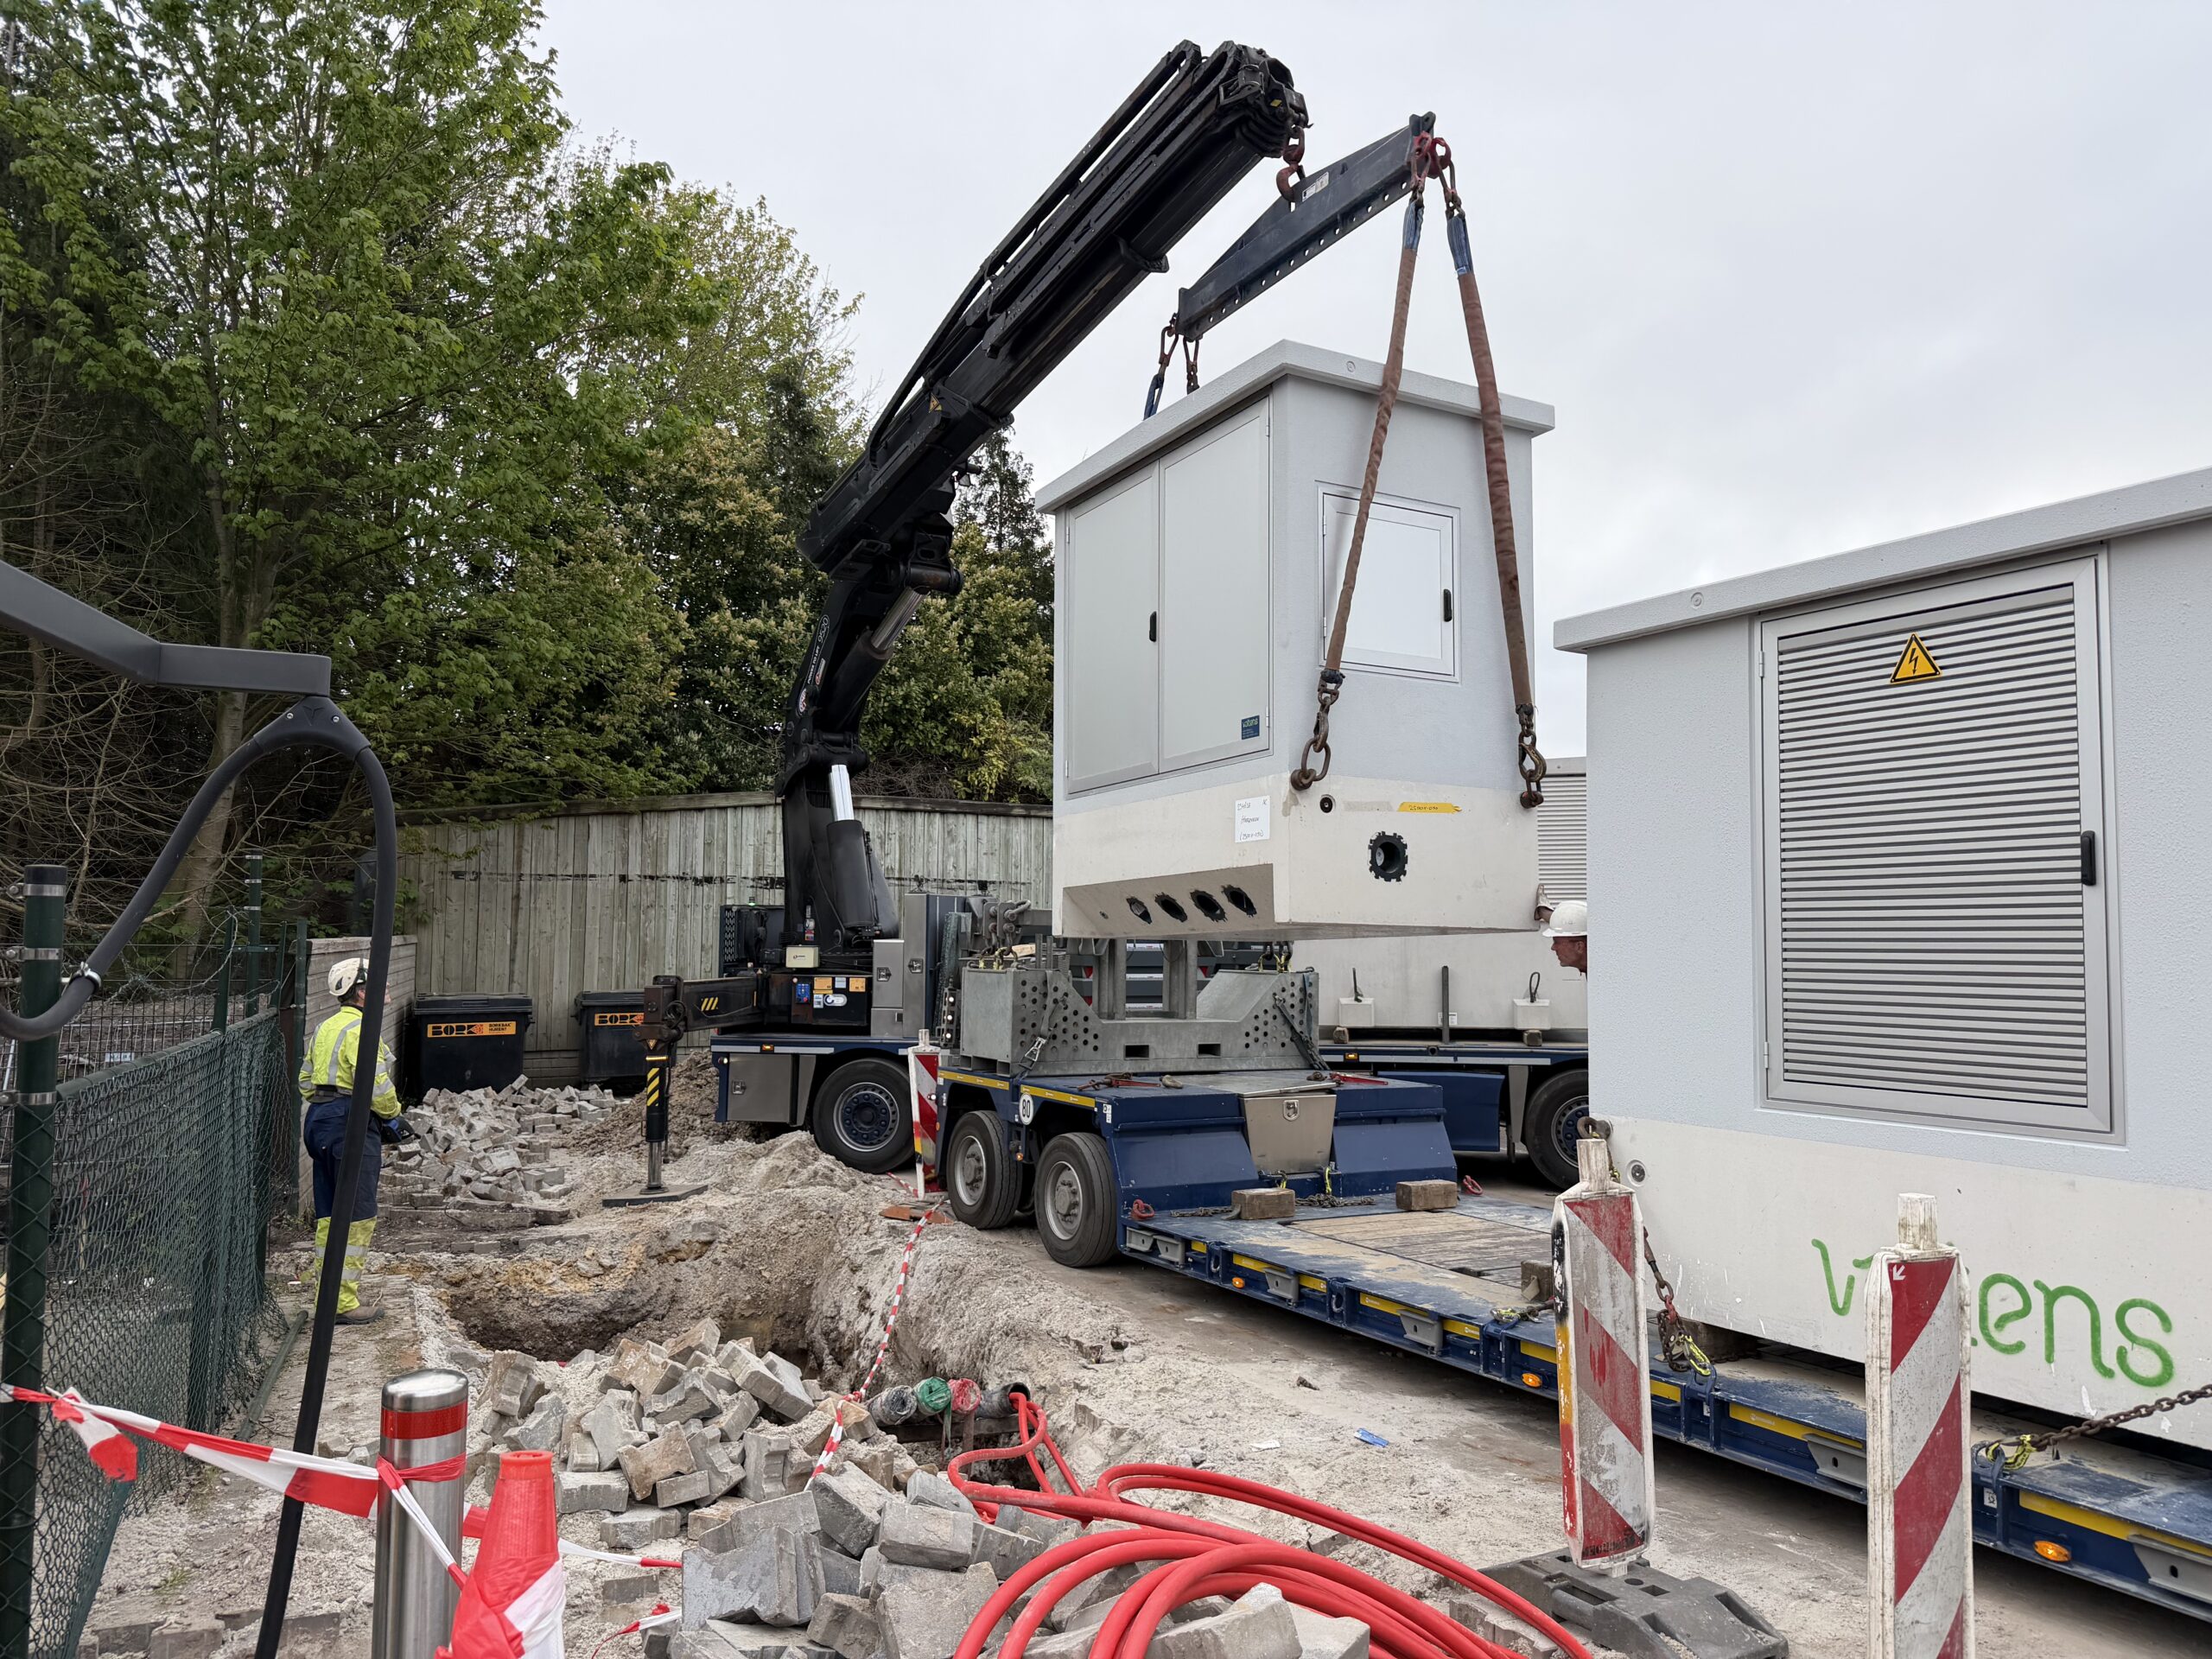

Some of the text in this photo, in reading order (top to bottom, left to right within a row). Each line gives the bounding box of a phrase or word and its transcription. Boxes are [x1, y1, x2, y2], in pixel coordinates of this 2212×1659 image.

[817, 617, 829, 644] 9520
[598, 1014, 641, 1025] BORK
[431, 1024, 480, 1036] BORK
[1021, 1099, 1031, 1119] 80
